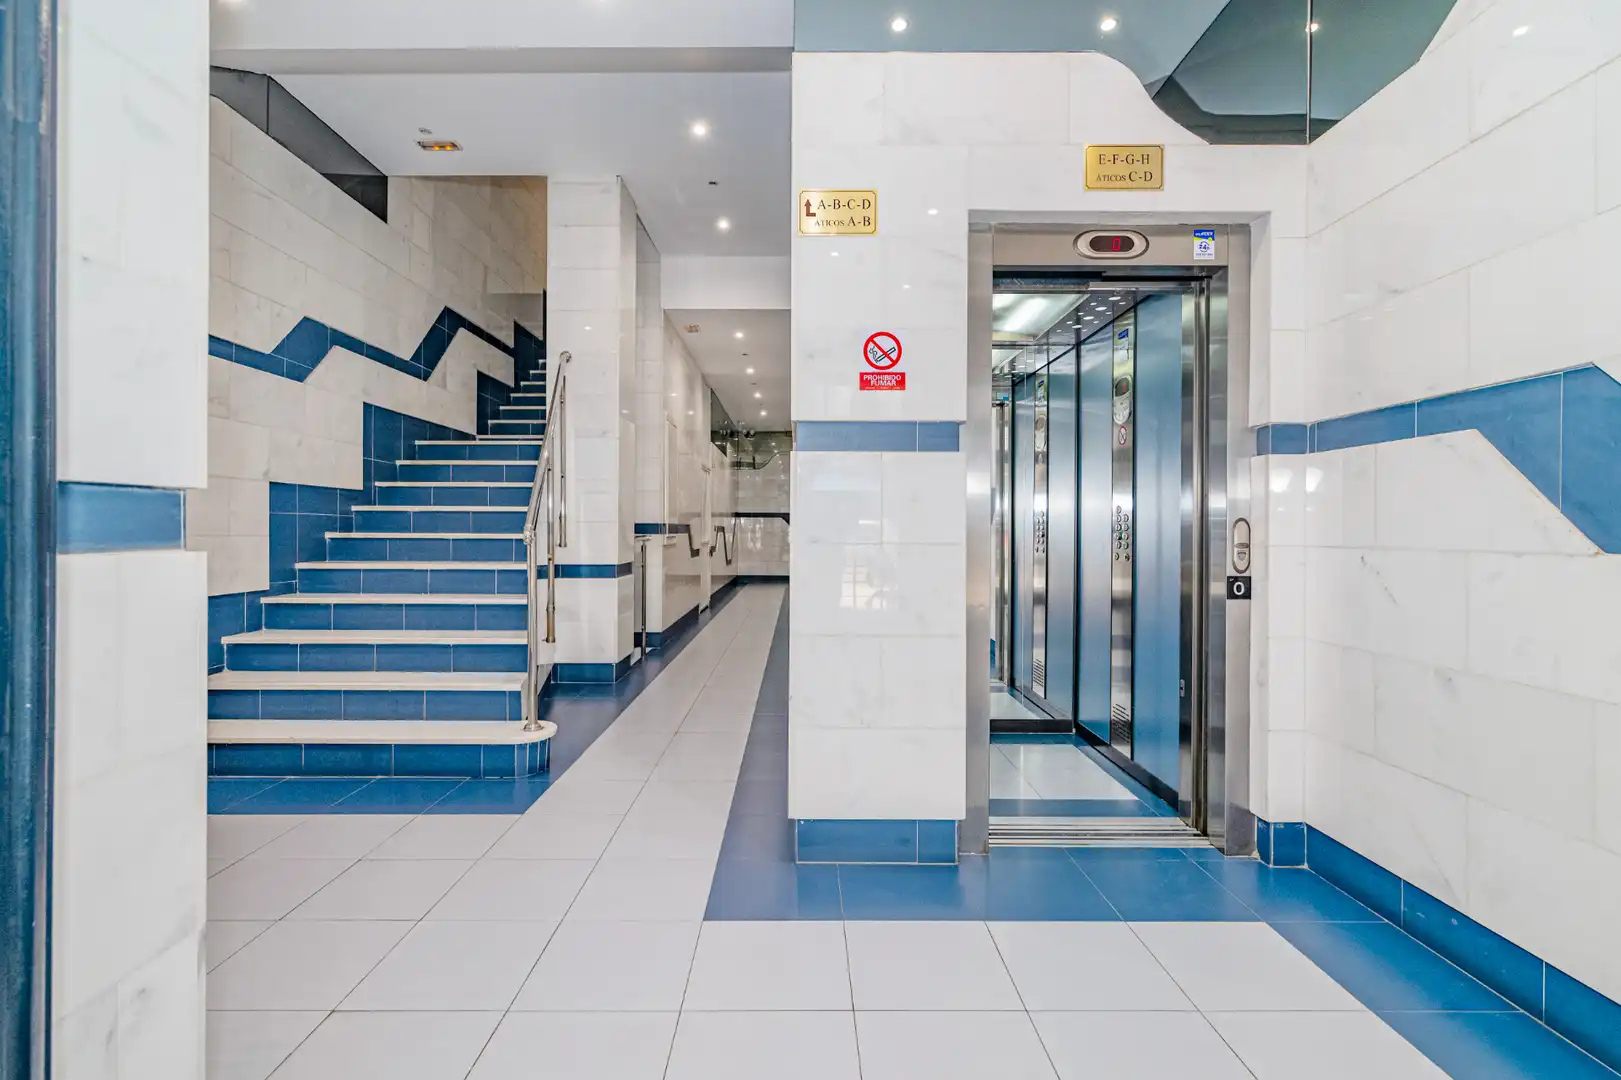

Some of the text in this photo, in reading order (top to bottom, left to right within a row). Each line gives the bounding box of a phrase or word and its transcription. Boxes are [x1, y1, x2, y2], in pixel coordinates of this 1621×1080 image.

[1098, 153, 1150, 165] E-F-G-H
[1128, 170, 1153, 182] C-D
[817, 198, 871, 210] A-B-C-D
[847, 215, 871, 227] A-B
[1111, 236, 1121, 252] 0
[1233, 581, 1245, 596] 0
